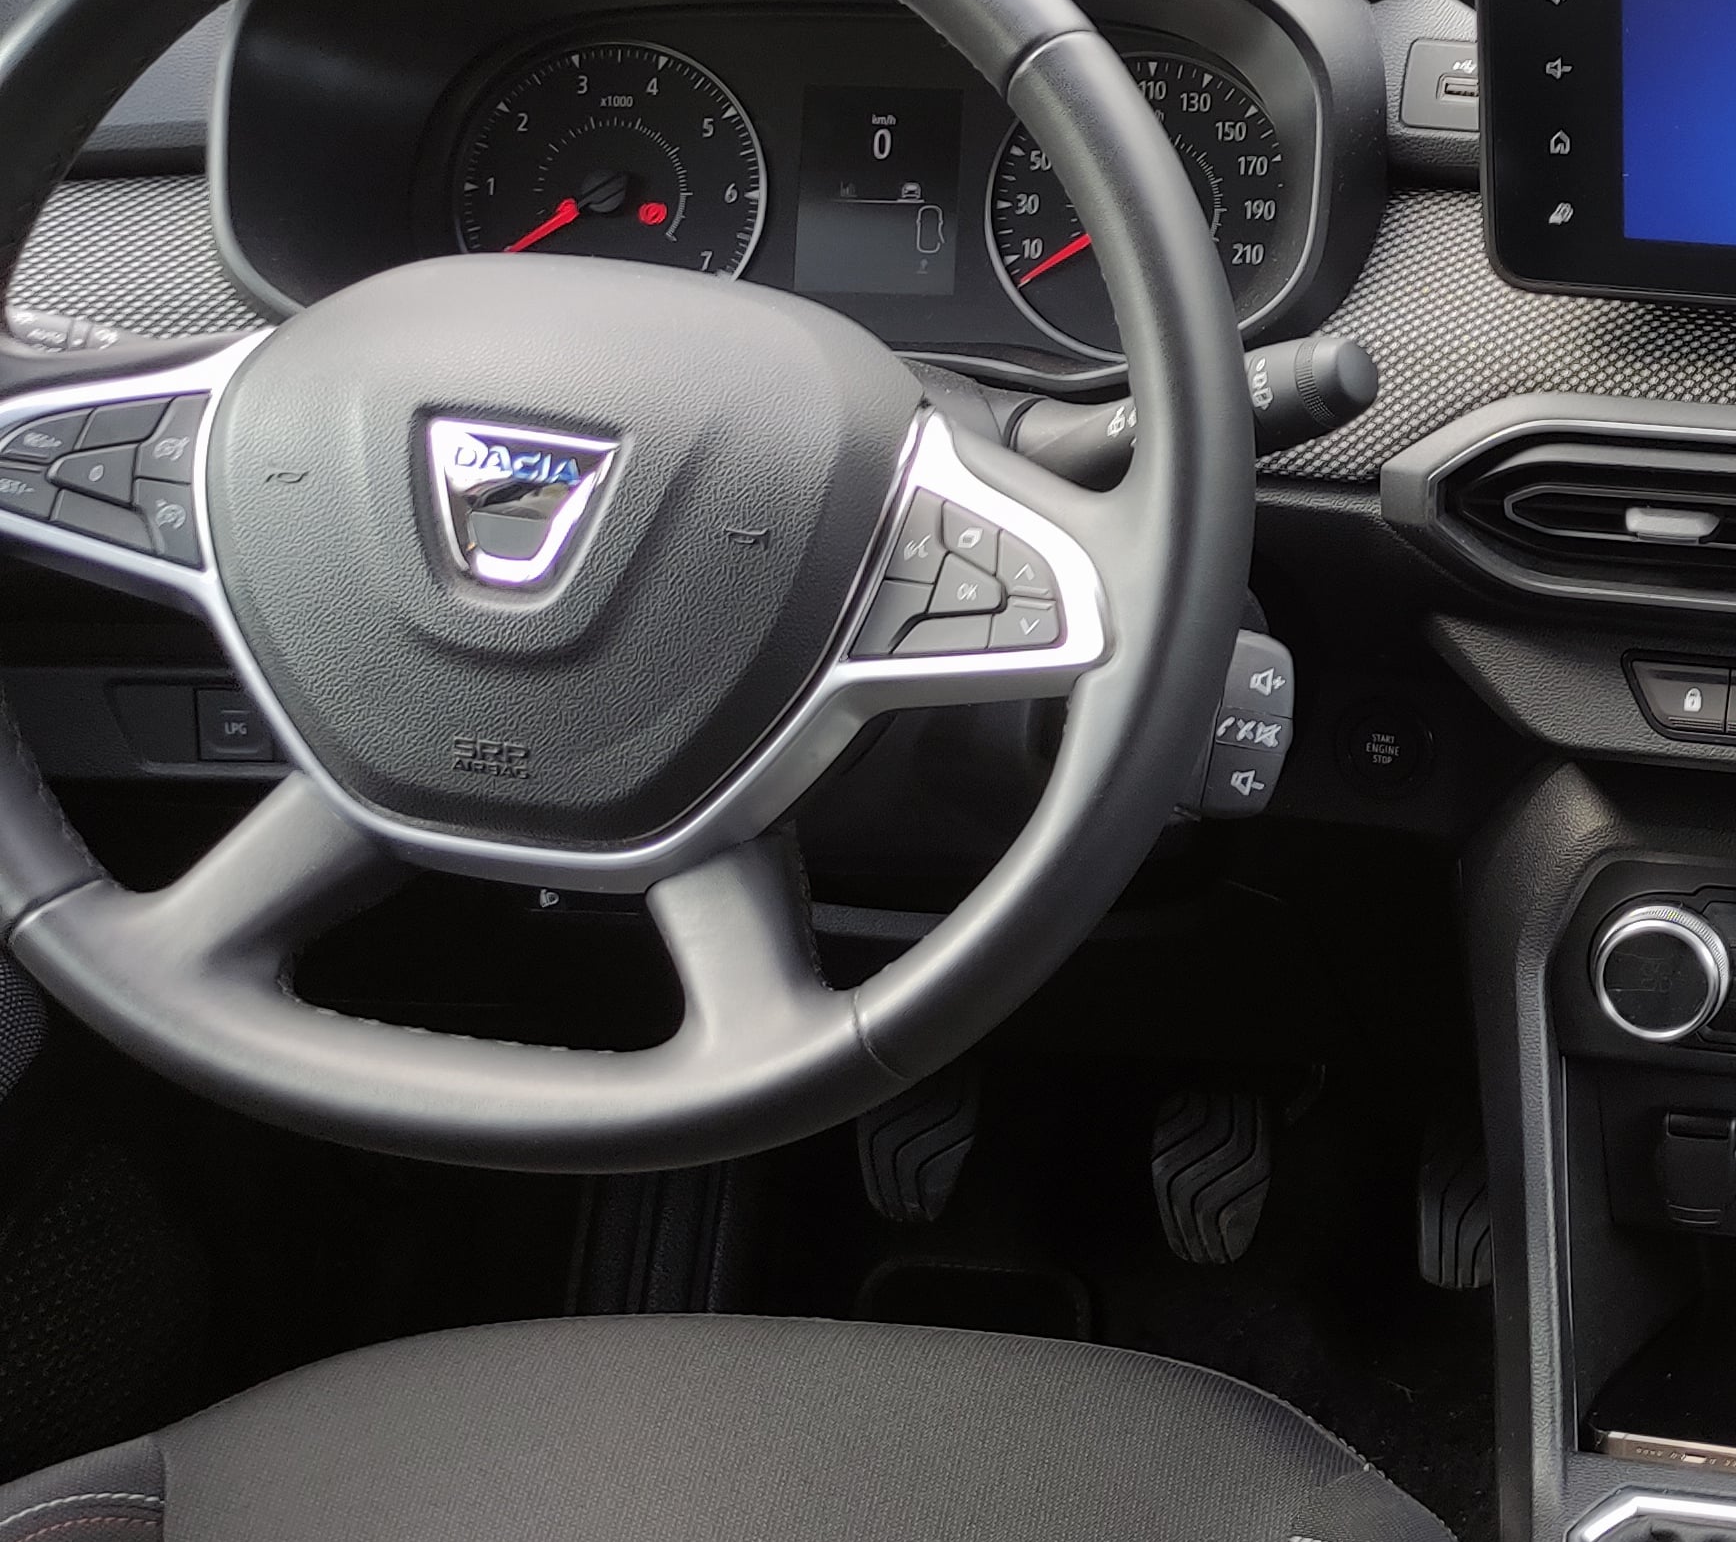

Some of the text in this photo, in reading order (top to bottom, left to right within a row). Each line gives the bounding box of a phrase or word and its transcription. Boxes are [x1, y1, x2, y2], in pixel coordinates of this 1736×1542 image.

[576, 75, 588, 95] 3
[646, 77, 659, 97] 4
[1138, 80, 1167, 100] 110
[600, 95, 633, 109] x1000
[1180, 92, 1211, 112] 130
[516, 113, 529, 133] 2
[702, 117, 715, 139] 5
[1215, 121, 1247, 142] 150
[873, 128, 892, 160] 0
[1237, 156, 1268, 176] 170
[486, 177, 495, 195] 1
[724, 182, 738, 204] 6
[1015, 193, 1039, 215] 30
[1244, 200, 1276, 221] 190
[1022, 238, 1043, 259] 10
[1232, 243, 1265, 265] 210
[455, 445, 582, 486] DACIA
[224, 721, 248, 735] LPG
[1371, 733, 1395, 744] START
[1365, 742, 1400, 757] ENGINE
[1372, 754, 1393, 764] STOP
